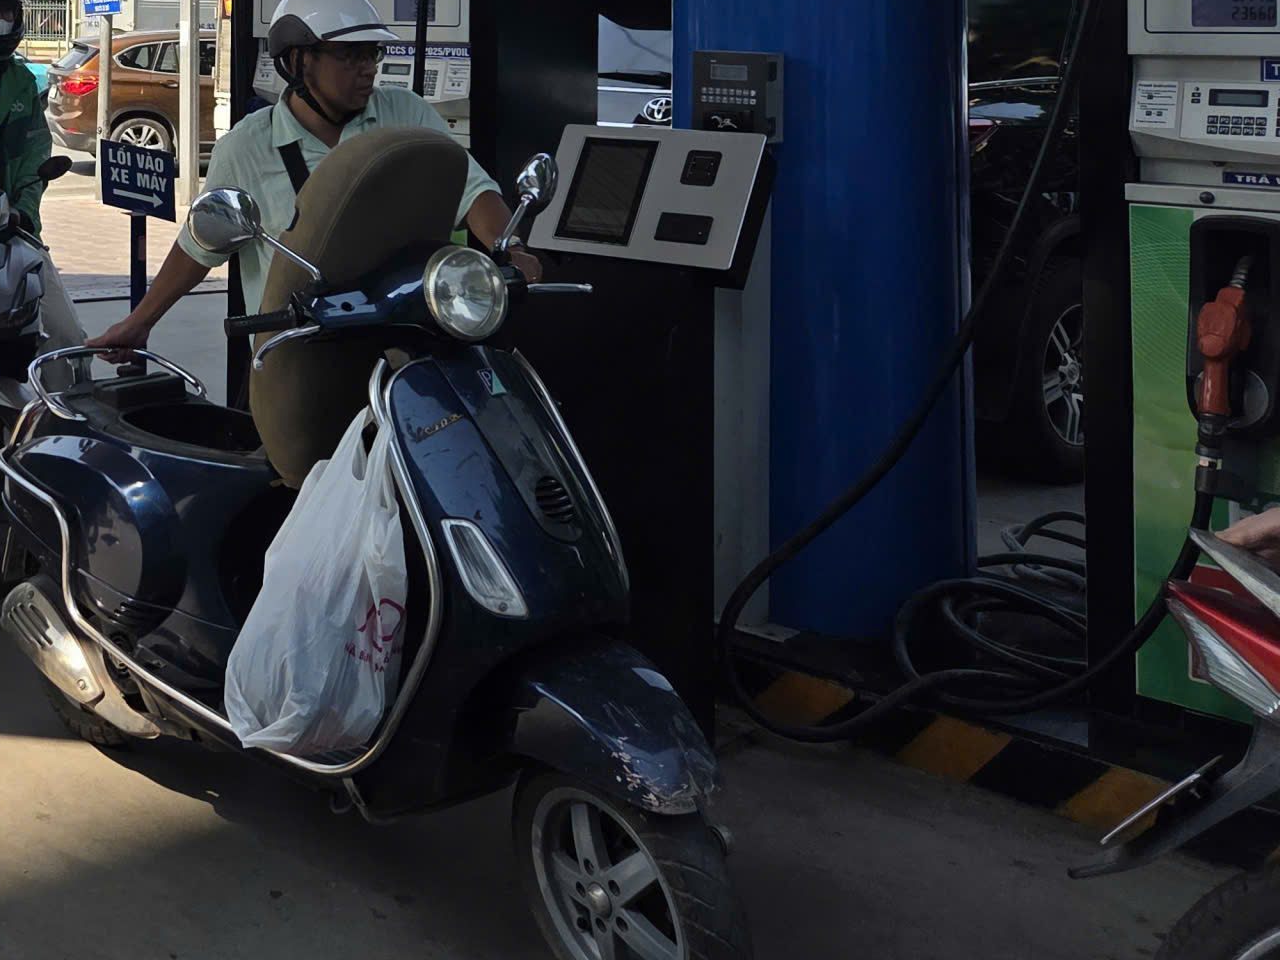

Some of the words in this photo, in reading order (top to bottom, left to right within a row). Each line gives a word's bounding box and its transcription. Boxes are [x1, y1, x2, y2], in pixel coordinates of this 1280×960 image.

[386, 46, 406, 55] TCCS
[108, 145, 131, 166] LỐI
[136, 152, 164, 173] VÀO
[110, 166, 129, 184] XE
[136, 172, 167, 192] MÁY
[1235, 174, 1270, 184] TRẢ
